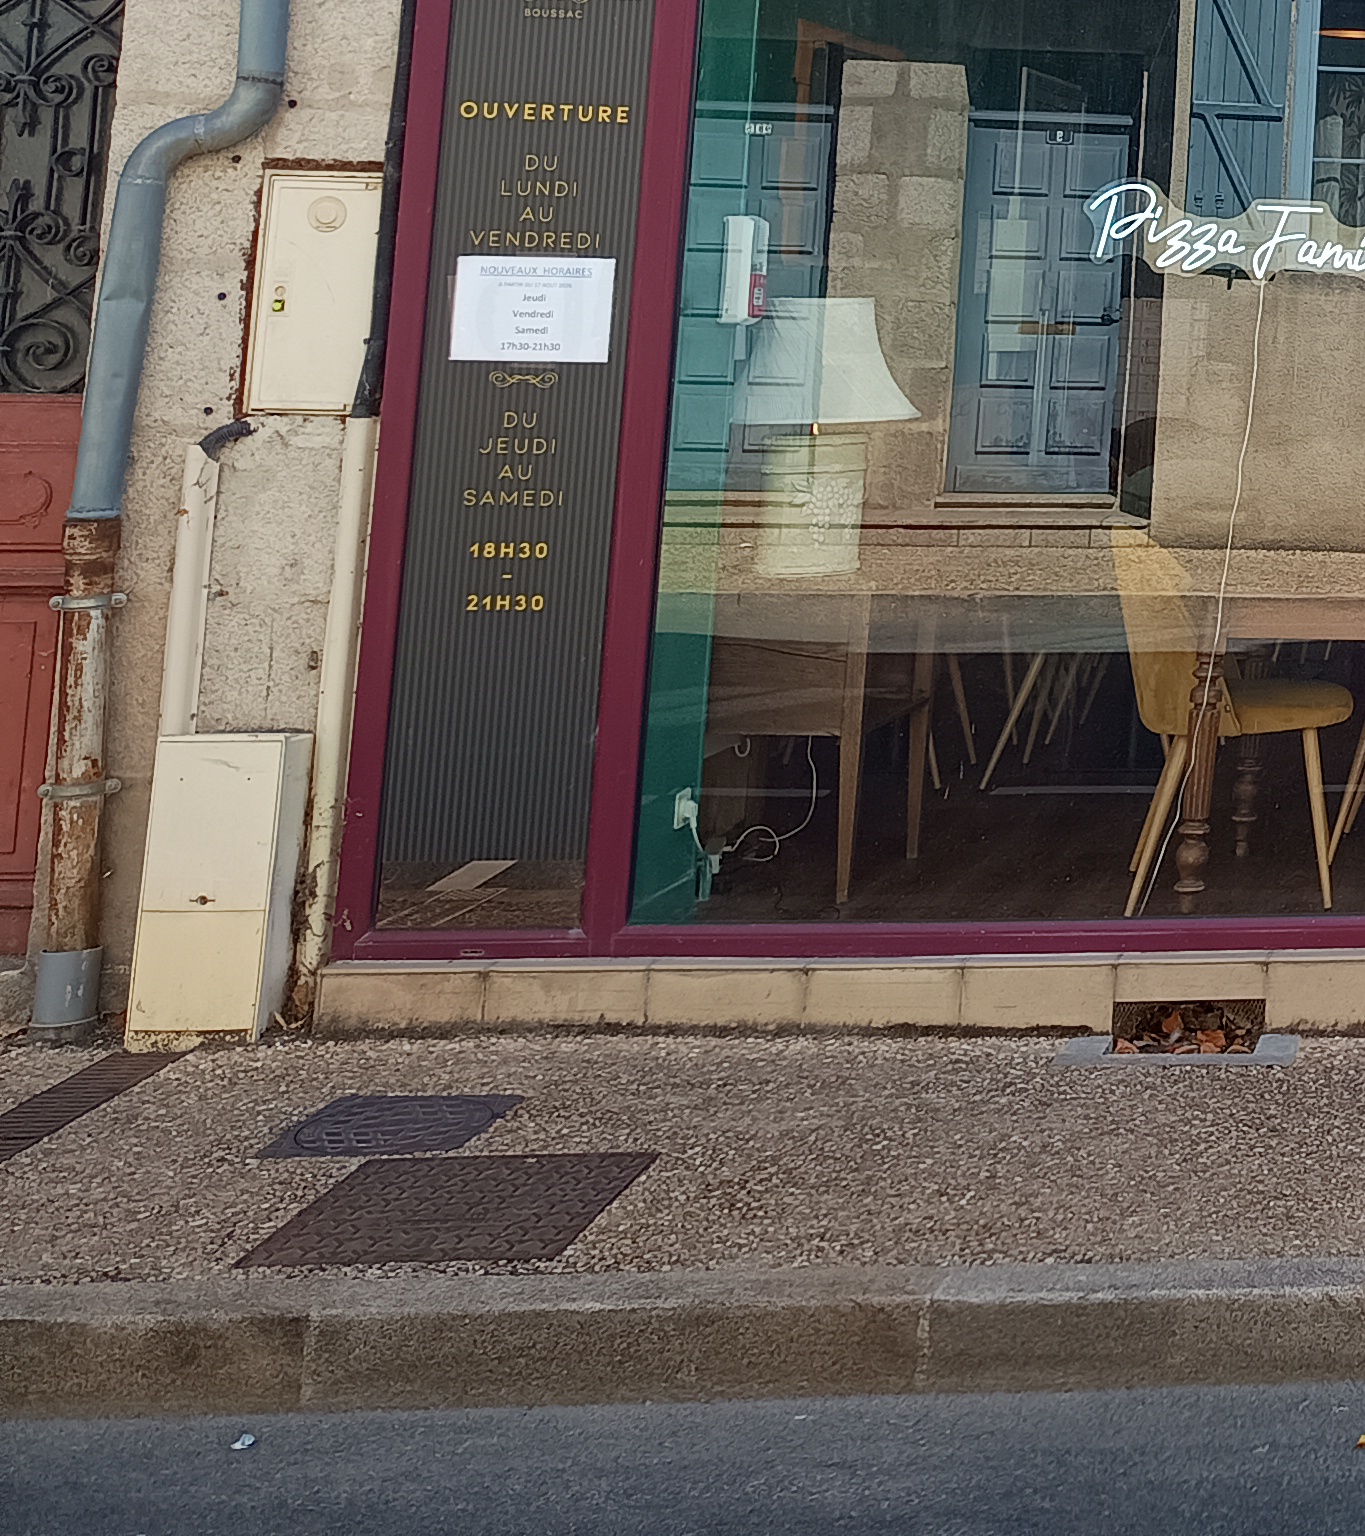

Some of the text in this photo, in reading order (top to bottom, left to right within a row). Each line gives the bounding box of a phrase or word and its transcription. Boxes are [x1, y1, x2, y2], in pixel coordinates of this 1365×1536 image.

[525, 8, 582, 19] BOUSSAC
[460, 100, 630, 124] OUVERTURE
[525, 155, 557, 172] DU
[500, 180, 577, 197] LUNDI
[520, 206, 554, 222] AU
[1089, 182, 1246, 272] Pizza
[470, 231, 600, 249] VENDREDI
[480, 265, 593, 278] NOUVEAUX HORAIRES
[522, 294, 546, 302] Jeudi
[513, 310, 553, 318] Vendredi
[515, 326, 548, 334] Samedi
[500, 342, 560, 351] 17h30-21h30
[504, 411, 537, 428] DU
[480, 438, 557, 454] JEUDI
[499, 464, 533, 480] AU
[463, 490, 564, 507] SAMEDI
[469, 543, 548, 559] 18H30
[466, 595, 544, 611] 21H30
